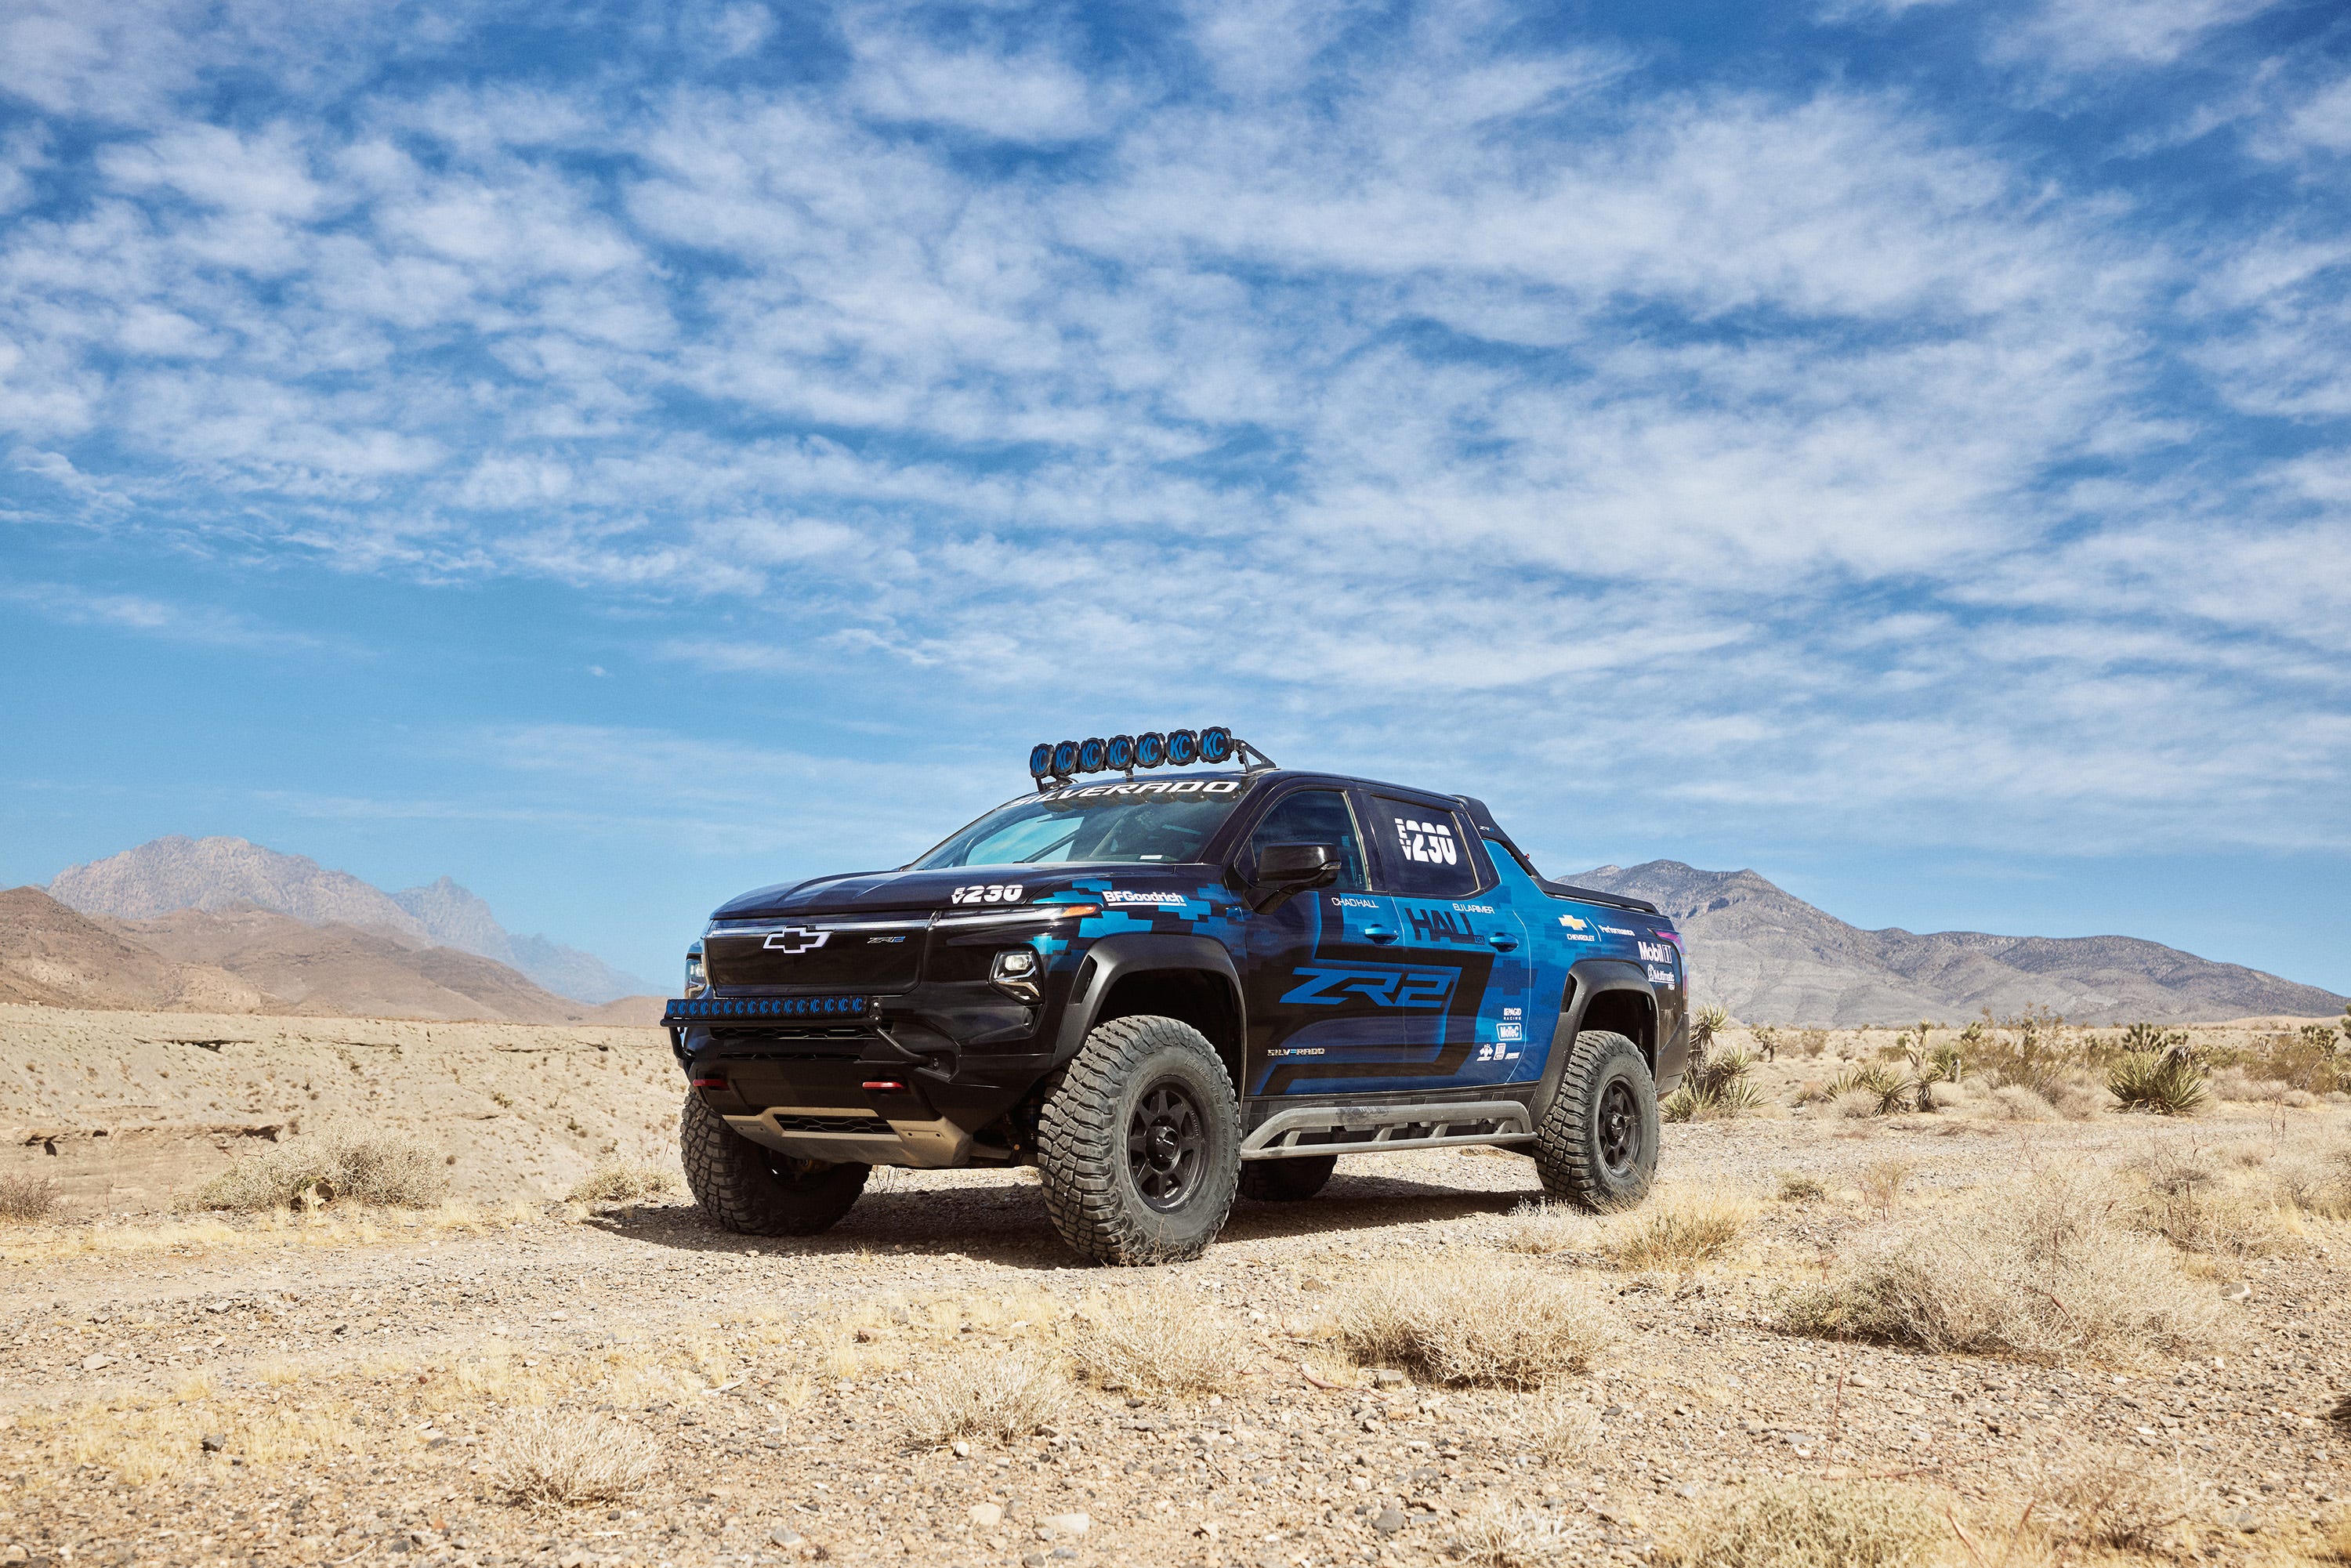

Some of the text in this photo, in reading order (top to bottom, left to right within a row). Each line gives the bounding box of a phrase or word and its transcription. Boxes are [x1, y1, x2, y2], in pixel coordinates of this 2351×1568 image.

[1139, 737, 1159, 764] KC
[1170, 734, 1190, 761] KC
[1202, 731, 1225, 758] KC
[1032, 748, 1048, 773] KC
[1056, 746, 1073, 771] KC
[1081, 744, 1099, 770] KC
[1109, 741, 1128, 766] KC
[1003, 782, 1240, 810] SILVERADO
[1103, 891, 1185, 903] BFGoodrich
[1331, 897, 1379, 908] CHAD HALL
[1405, 907, 1475, 944] HALL
[1567, 933, 1596, 942] CHEVROLET
[1637, 941, 1664, 962] Mobil
[1279, 967, 1452, 1008] ZR2
[723, 1001, 732, 1014] KC
[735, 1001, 744, 1014] KC
[747, 1001, 756, 1014] KC
[759, 1000, 768, 1014] KC
[772, 1000, 781, 1014] KC
[784, 999, 793, 1013] KC
[797, 999, 806, 1013] KC
[810, 998, 820, 1013] KC
[824, 998, 834, 1012] KC
[839, 998, 848, 1012] KC
[853, 998, 862, 1012] KC
[1500, 1026, 1520, 1038] MoTeC
